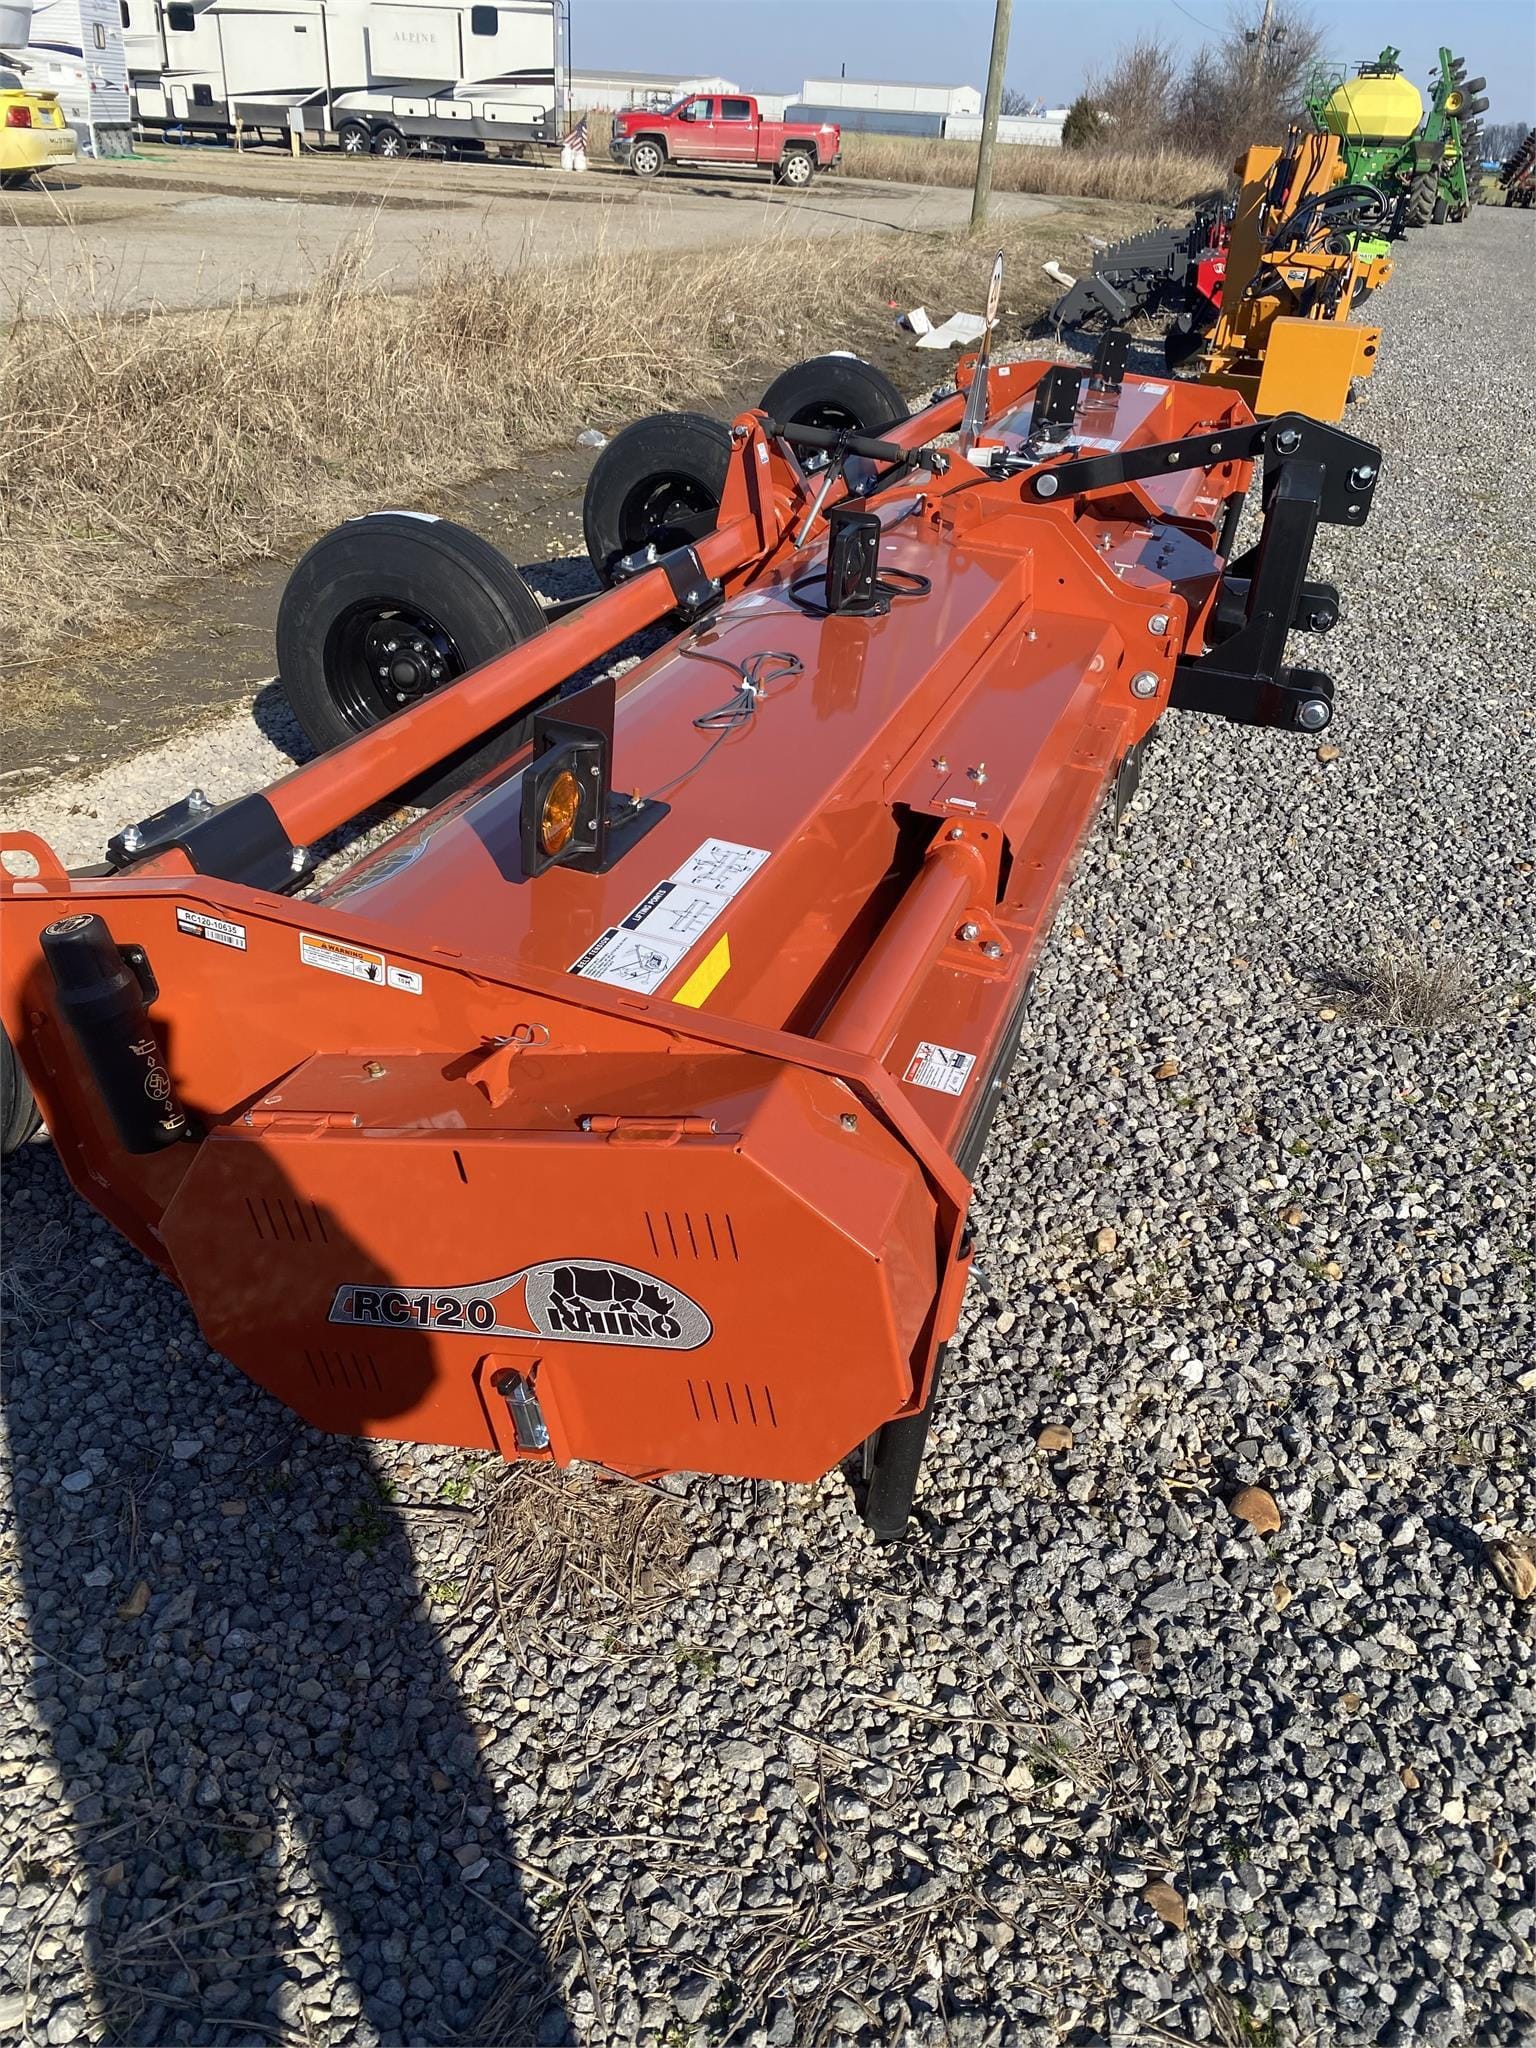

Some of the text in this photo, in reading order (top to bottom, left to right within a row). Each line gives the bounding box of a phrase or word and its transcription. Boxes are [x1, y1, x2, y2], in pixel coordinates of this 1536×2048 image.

[393, 31, 438, 44] ALPINE
[632, 889, 667, 922] LIFTING POINTS
[185, 912, 237, 934] RC120-10635
[327, 944, 364, 959] WARNING
[351, 1288, 683, 1341] RC120 RHINO
